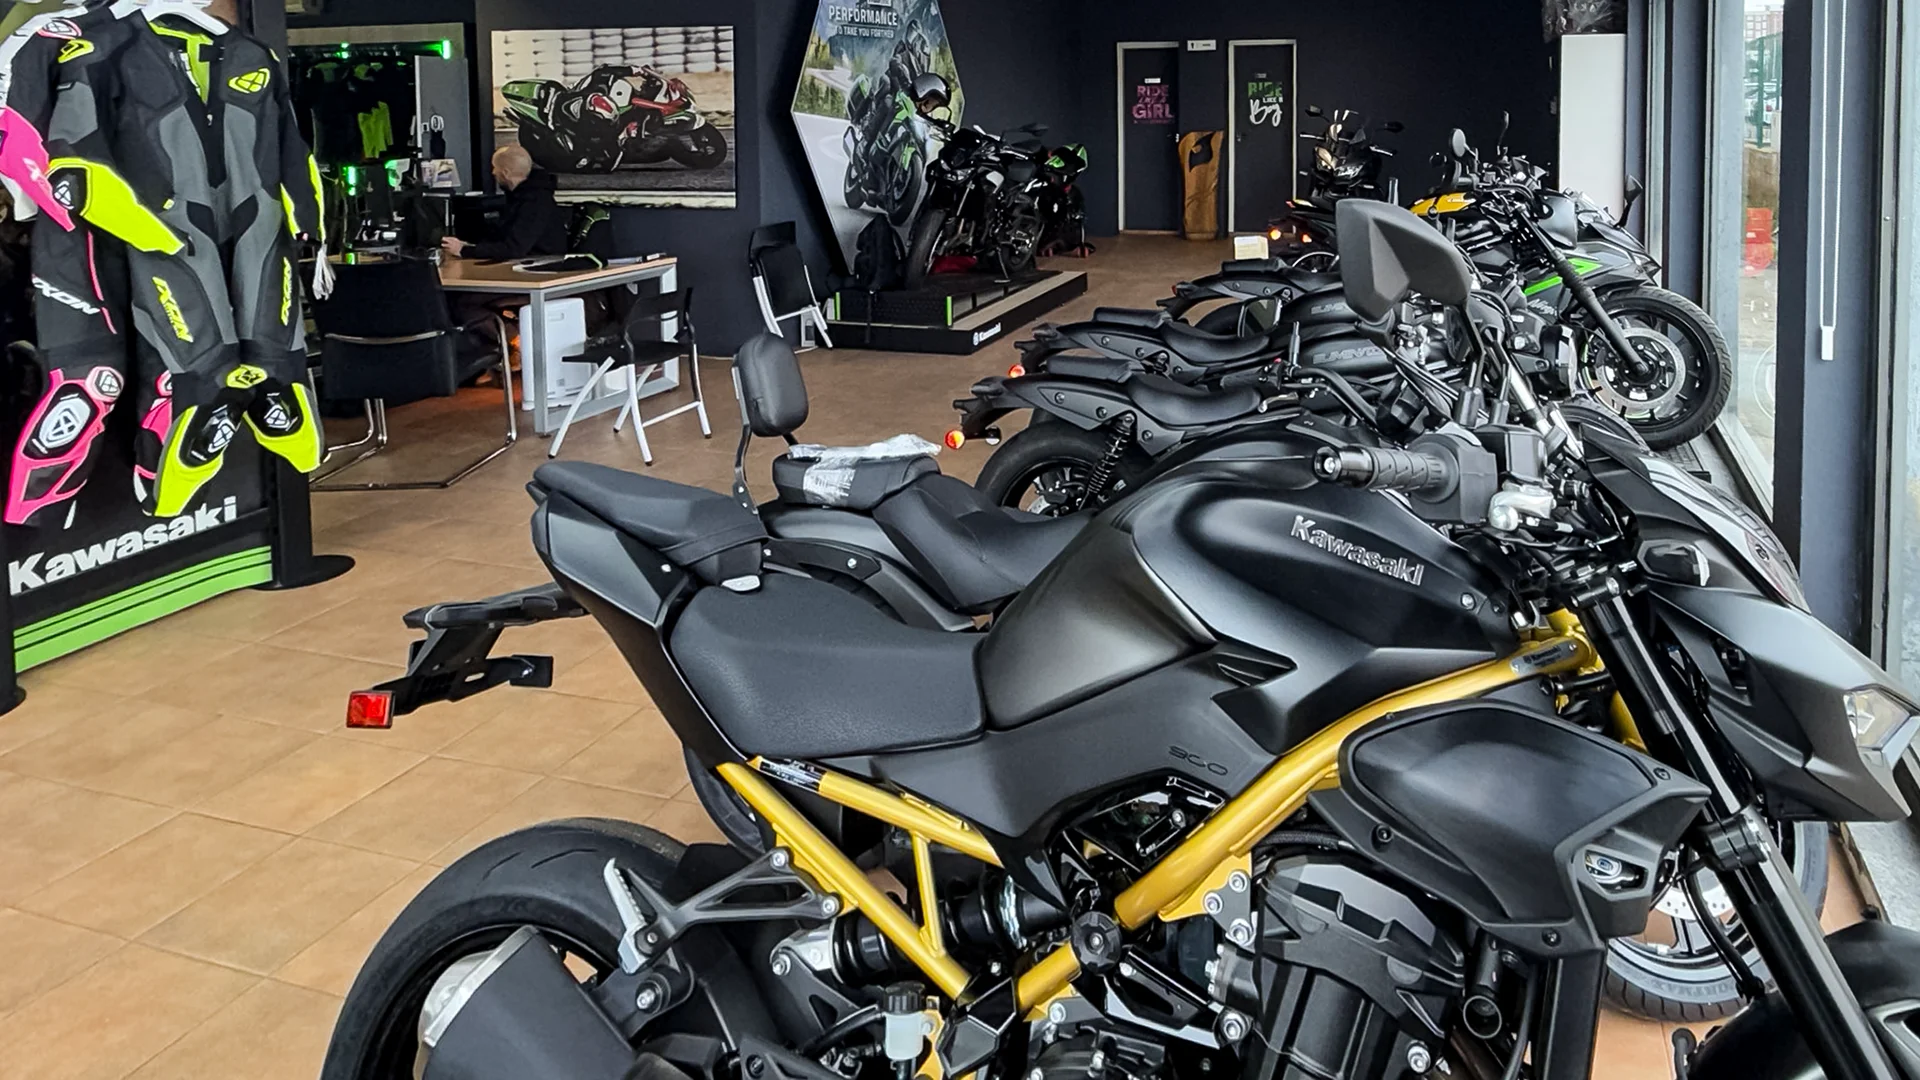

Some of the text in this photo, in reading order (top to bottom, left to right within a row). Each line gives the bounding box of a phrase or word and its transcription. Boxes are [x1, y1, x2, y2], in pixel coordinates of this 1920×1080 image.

[828, 4, 898, 26] PERFORMANCE
[1137, 85, 1169, 97] RIDE
[1249, 98, 1283, 127] Boy
[152, 276, 194, 343] IXON
[8, 496, 237, 596] Kawasaki
[1290, 515, 1425, 586] Kawasaki
